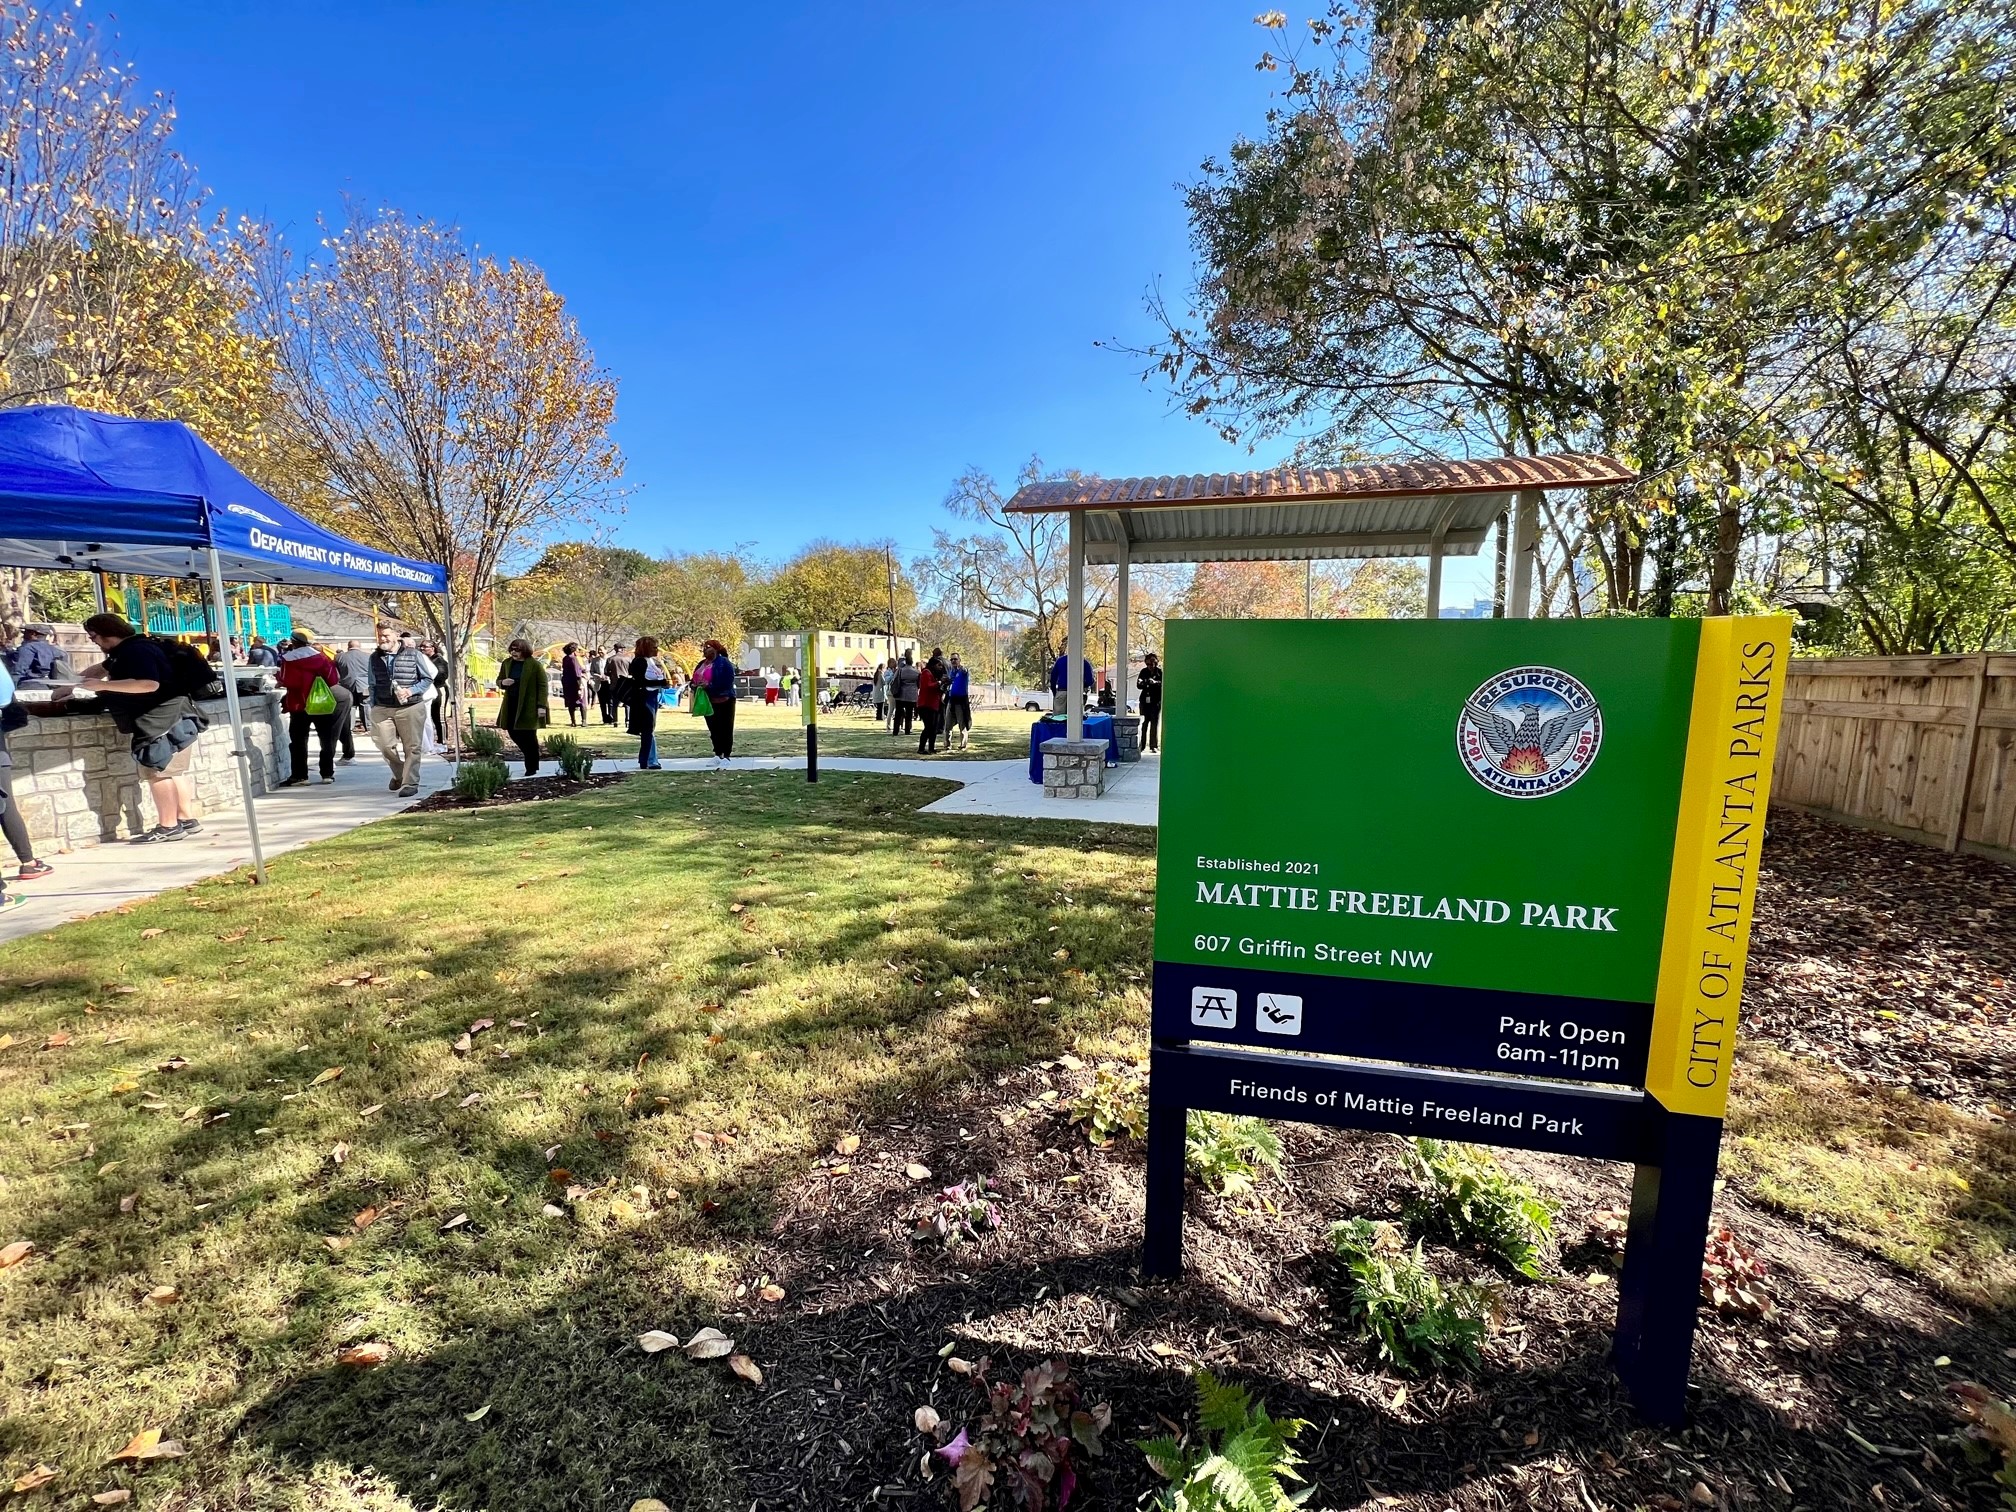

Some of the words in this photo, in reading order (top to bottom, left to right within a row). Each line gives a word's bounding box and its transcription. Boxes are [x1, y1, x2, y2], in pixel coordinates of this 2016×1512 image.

[250, 528, 327, 564] DEPARTMENT
[328, 552, 342, 566] OF
[343, 552, 372, 573] PARKS
[374, 562, 391, 575] AND
[391, 562, 435, 584] RECREATION
[1476, 674, 1587, 709] RESURGENS
[1729, 641, 1775, 759] PARKS
[1466, 730, 1483, 762] 1847
[1572, 730, 1592, 763] 1865
[1197, 856, 1280, 873] Established
[1285, 861, 1319, 875] 2021
[1706, 771, 1757, 943] ATLANTA
[1195, 881, 1319, 911] MATTIE
[1327, 889, 1511, 924] FREELAND
[1520, 902, 1619, 932] PARK
[1194, 934, 1231, 952] 607
[1238, 937, 1306, 959] Griffin
[1314, 943, 1382, 965] Street
[1390, 949, 1433, 969] NW
[1699, 950, 1733, 999] OF
[1499, 1016, 1551, 1038] Park
[1559, 1021, 1625, 1045] Open
[1686, 1007, 1724, 1088] CITY
[1496, 1042, 1619, 1071] 6am-11pm
[1230, 1079, 1308, 1103] Friends
[1315, 1090, 1338, 1107] of
[1344, 1092, 1414, 1116] Mattie
[1422, 1101, 1523, 1129] Freeland
[1532, 1113, 1583, 1136] Park
